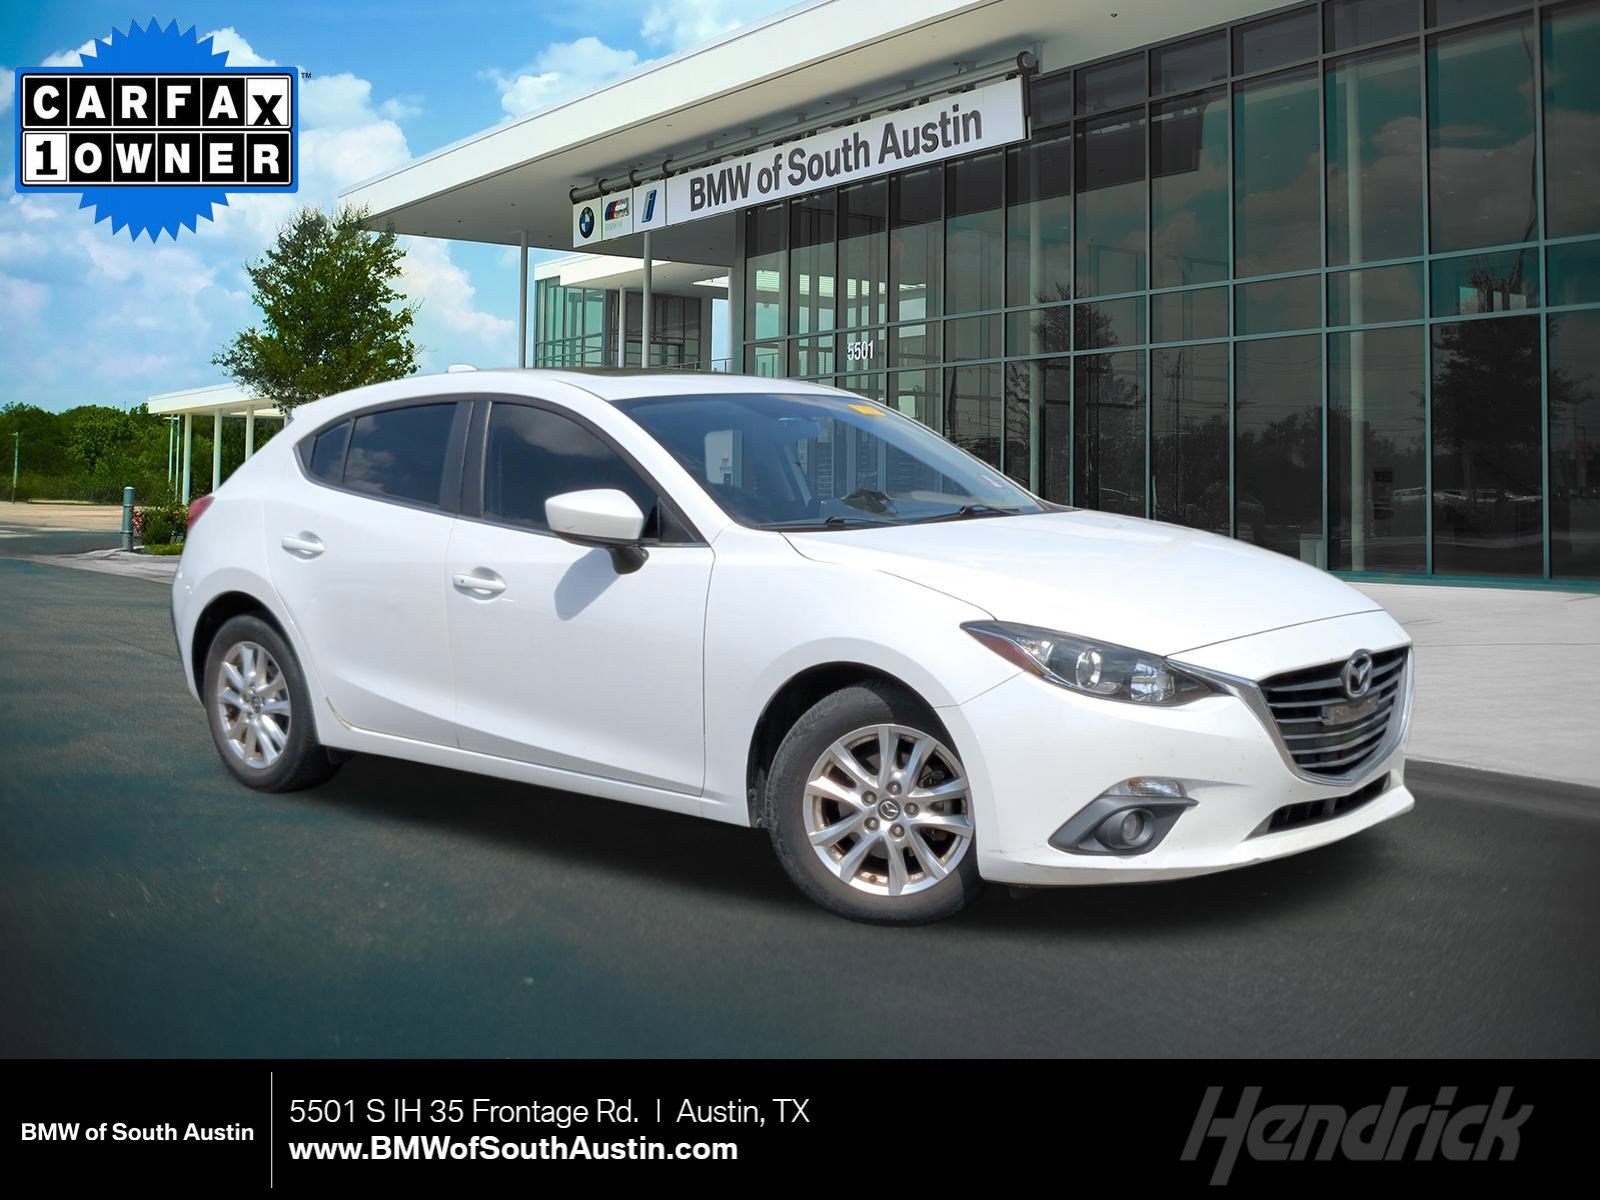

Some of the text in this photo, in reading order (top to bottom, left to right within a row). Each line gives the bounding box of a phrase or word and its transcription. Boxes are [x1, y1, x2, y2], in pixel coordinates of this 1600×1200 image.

[689, 162, 751, 212] BMW
[757, 153, 783, 194] of
[787, 132, 870, 187] South
[878, 104, 982, 165] Austin
[847, 340, 874, 360] 5501
